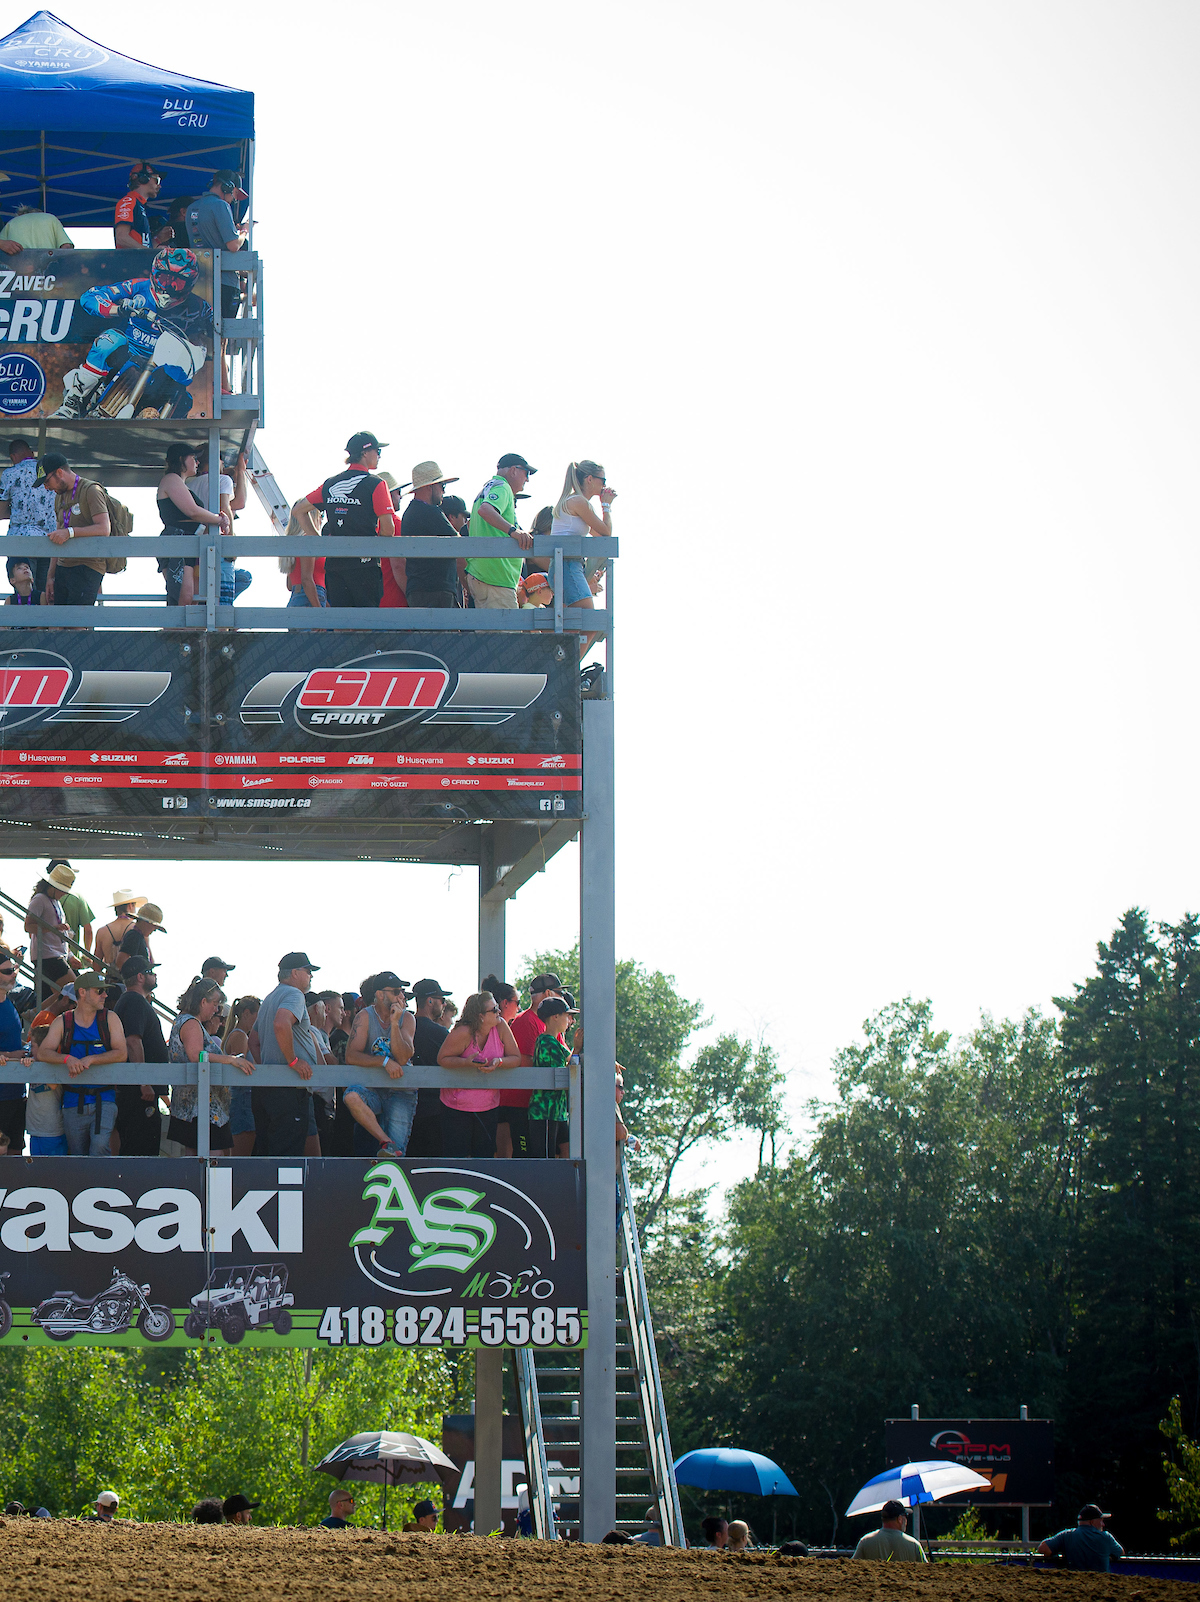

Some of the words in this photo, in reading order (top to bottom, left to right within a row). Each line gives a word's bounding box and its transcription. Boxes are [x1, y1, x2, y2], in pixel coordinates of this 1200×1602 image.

[28, 60, 71, 68] YAMAHA
[11, 275, 56, 291] AVEC
[327, 497, 361, 506] HONDA
[309, 712, 386, 725] SPORT
[28, 754, 67, 763] Husqvarna
[224, 755, 257, 765] YAMAHA
[347, 754, 375, 765] KTM
[405, 757, 444, 765] Husqvarna
[477, 757, 515, 765] SUZUKI
[241, 776, 274, 788] Vespa
[216, 797, 311, 809] www.smsport.ca
[519, 1135, 527, 1151] FOX
[349, 1161, 497, 1274] AS
[318, 1305, 385, 1345] 418
[394, 1305, 581, 1346] 824-5585
[937, 1443, 1011, 1456] RPM
[966, 1468, 1008, 1492] TM
